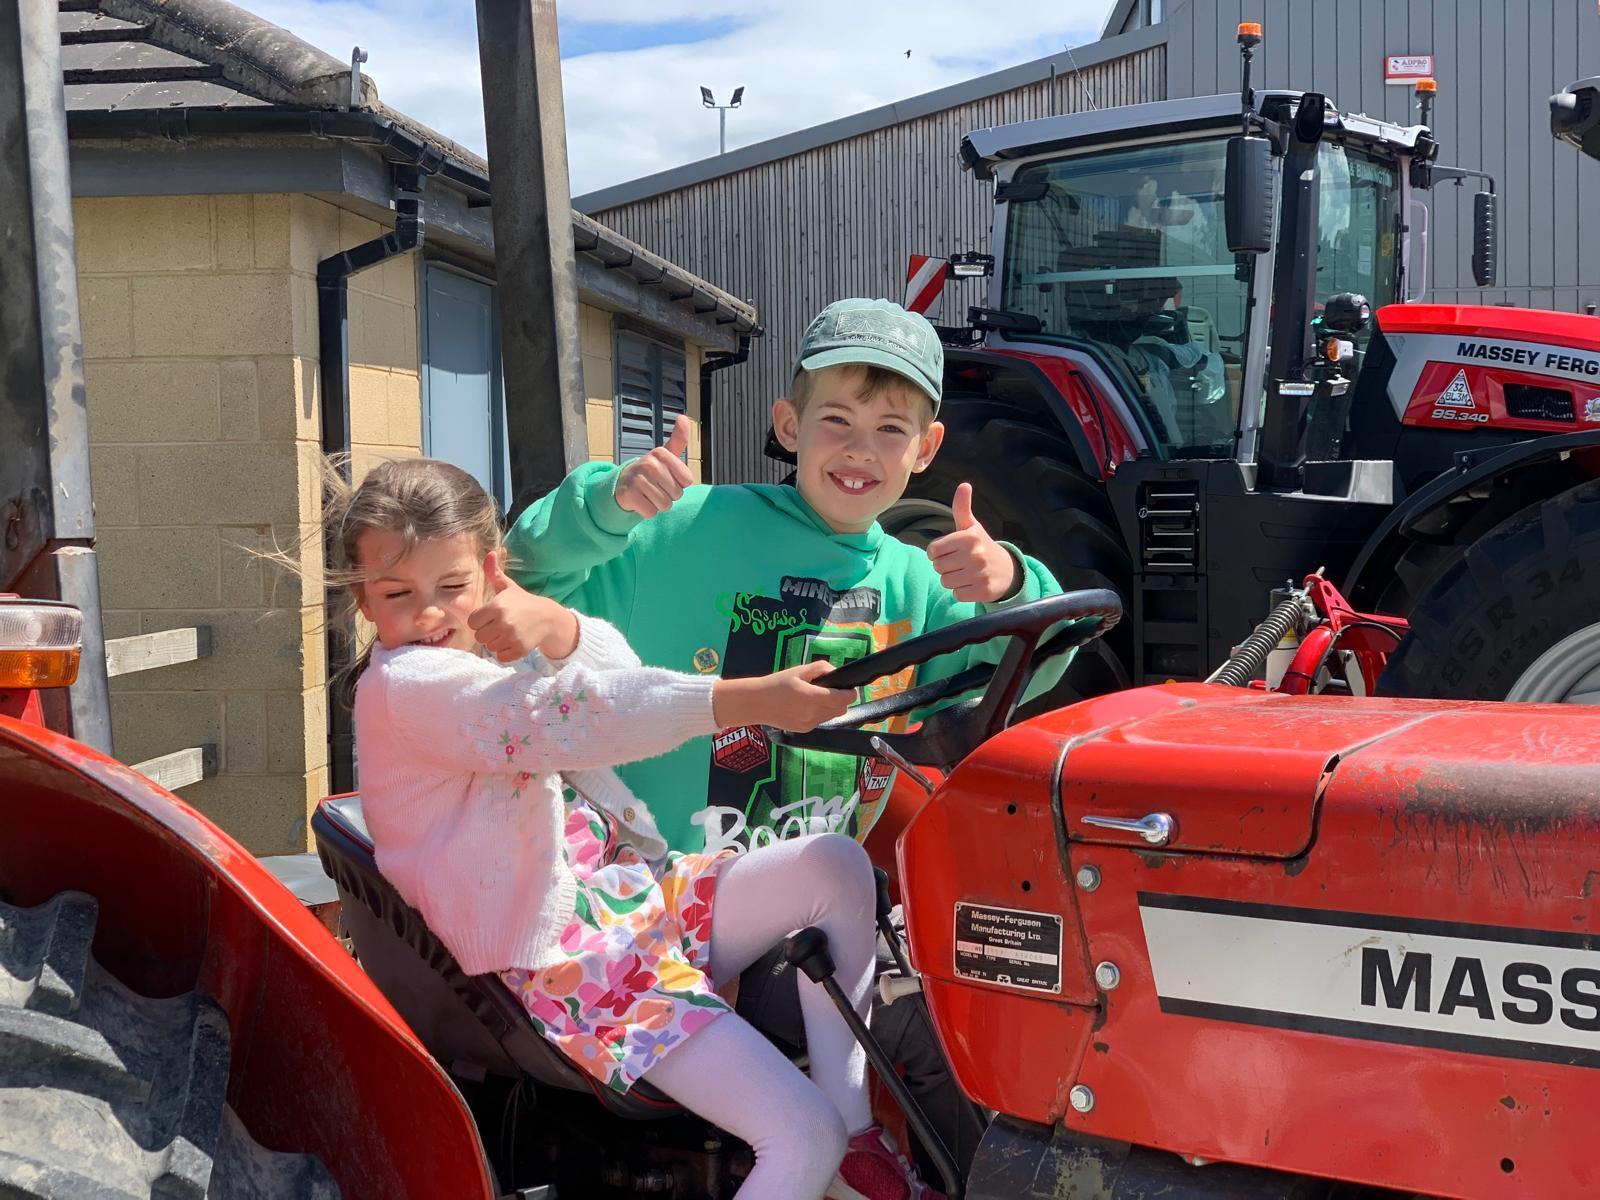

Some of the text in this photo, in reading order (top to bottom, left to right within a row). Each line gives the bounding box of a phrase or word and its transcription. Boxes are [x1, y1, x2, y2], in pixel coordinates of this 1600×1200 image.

[1456, 342, 1600, 376] MASSEY FERG
[1453, 383, 1465, 393] 32
[1431, 409, 1490, 423] 9S.340
[719, 729, 744, 747] TNT
[871, 777, 888, 788] TNT
[971, 910, 1041, 928] Massey-Ferguson
[970, 923, 1026, 940] Manufacturing
[988, 936, 1022, 946] Great Britain
[1360, 947, 1600, 1032] MASS
